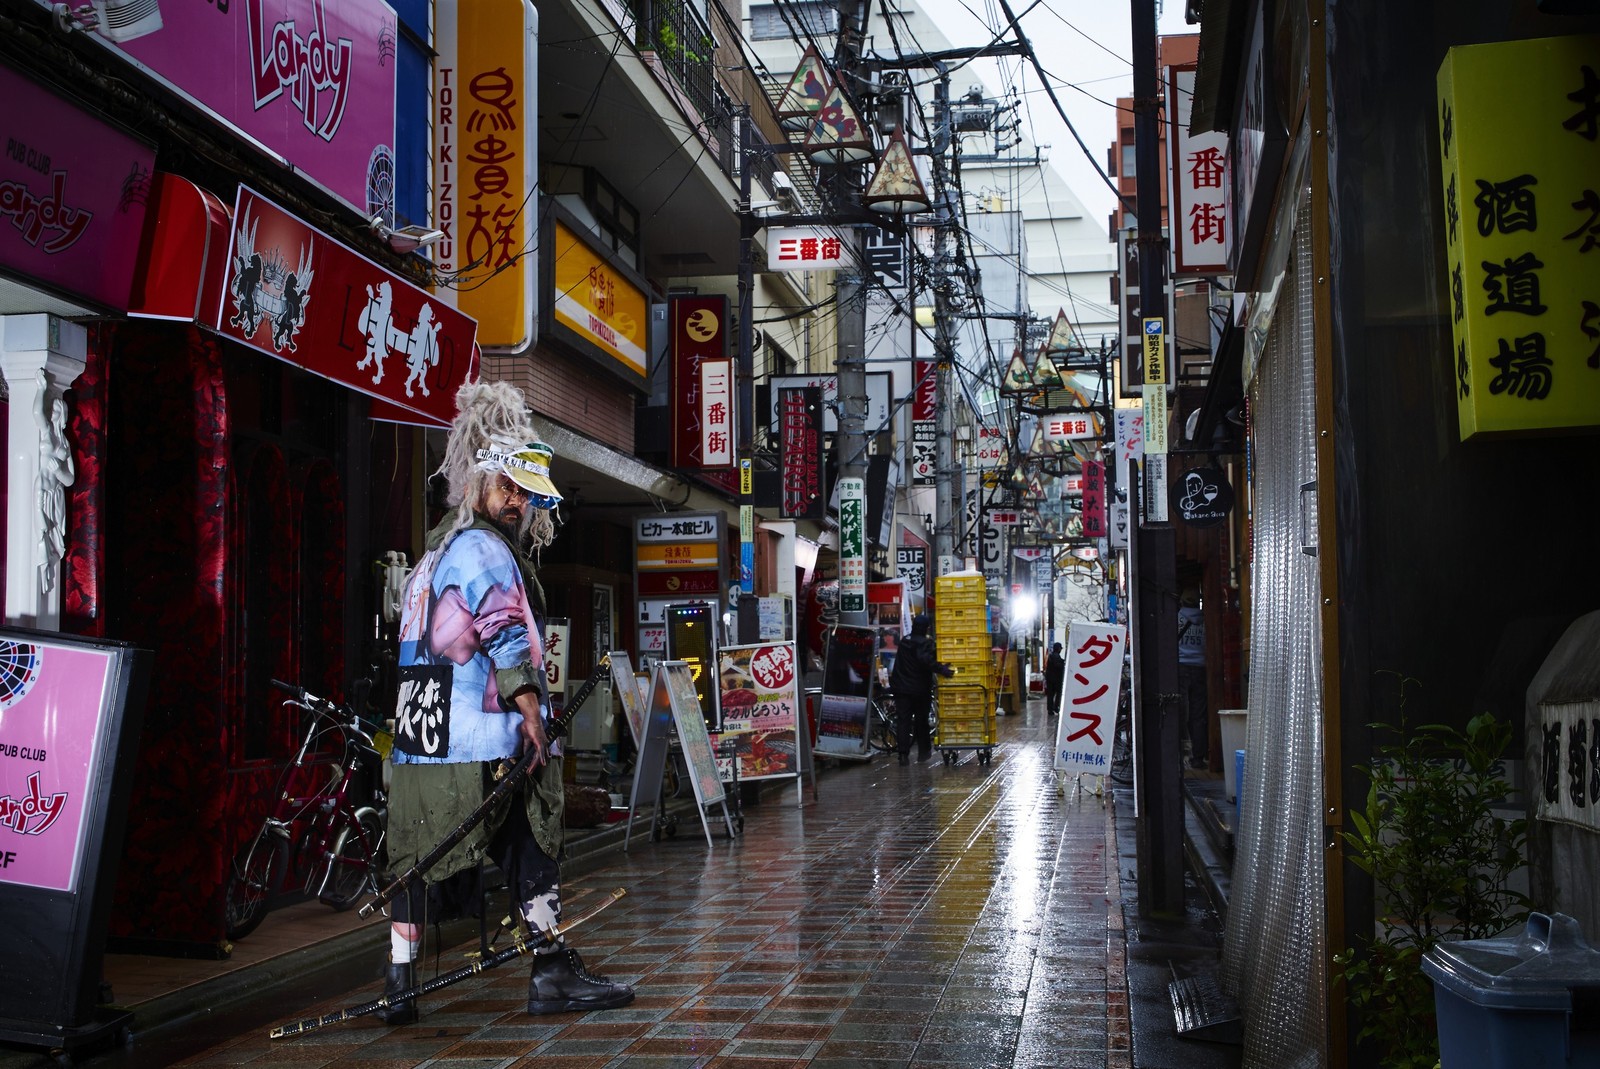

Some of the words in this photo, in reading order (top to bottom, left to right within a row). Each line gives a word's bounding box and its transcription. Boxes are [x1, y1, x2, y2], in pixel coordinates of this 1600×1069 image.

[246, 0, 352, 142] Landy
[7, 138, 26, 162] PUB
[27, 149, 51, 175] CLUB
[440, 69, 453, 260] TORIKIZOKU
[466, 66, 516, 267] 鳥貴族
[1187, 97, 1224, 245] 番街
[0, 170, 94, 254] andy
[779, 238, 841, 260] 三番街
[1475, 174, 1553, 400] 酒道場
[1148, 334, 1161, 381] 防犯カメラ作動中
[706, 374, 727, 453] 三番街
[1050, 420, 1086, 435] 三番街
[784, 395, 813, 514] HEARTS
[841, 500, 858, 554] マツザキ
[993, 514, 1017, 522] 三番街
[897, 551, 923, 562] B1F
[753, 646, 790, 678] 焼肉
[1067, 635, 1119, 745] ダンス
[0, 744, 18, 757] PUB
[20, 747, 46, 762] CLUB
[1061, 750, 1106, 767] 年中無休
[0, 771, 67, 834] andy
